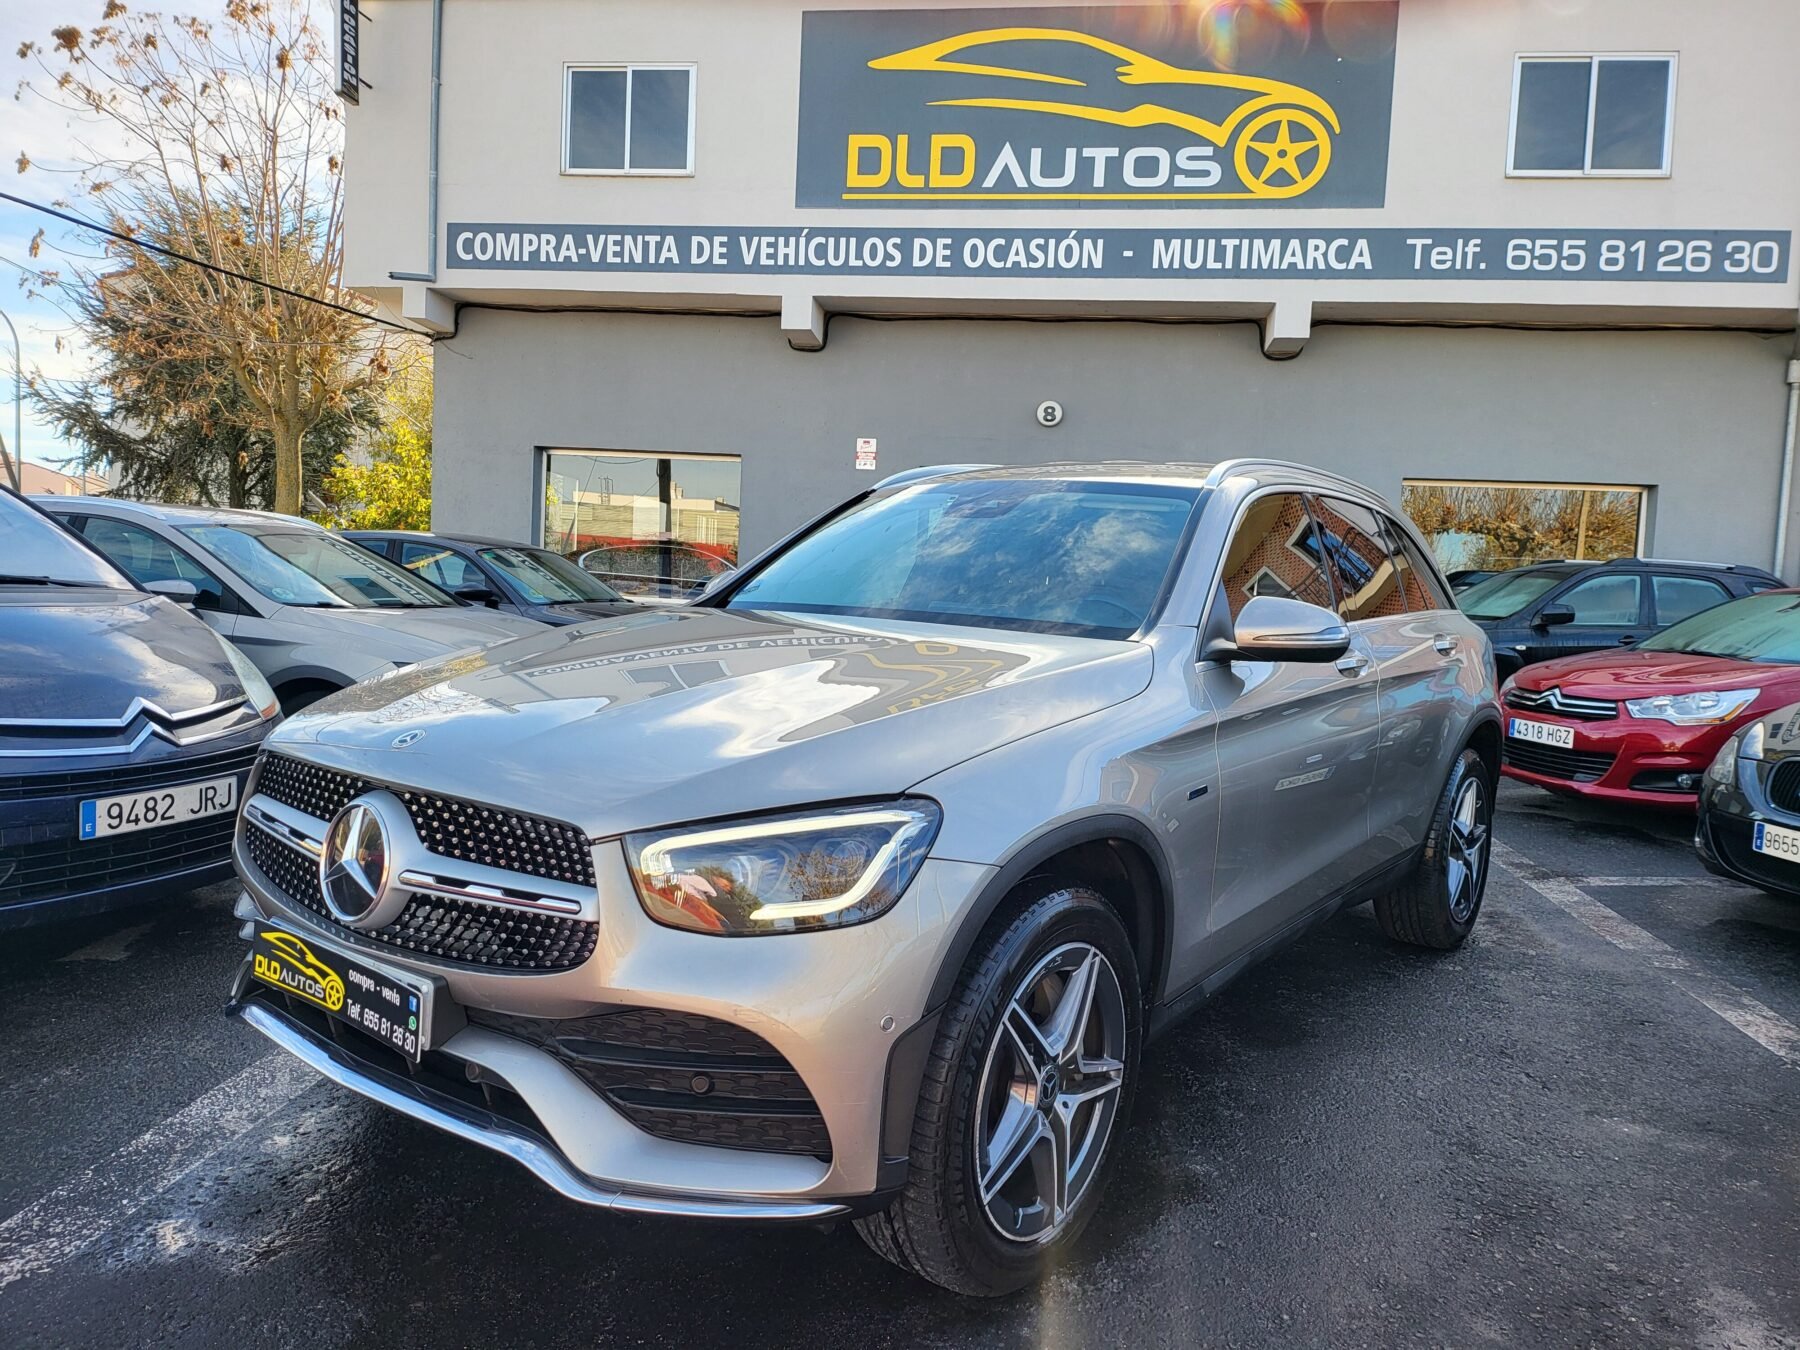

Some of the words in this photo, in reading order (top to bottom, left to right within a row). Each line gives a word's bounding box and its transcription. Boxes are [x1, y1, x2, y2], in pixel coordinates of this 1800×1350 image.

[847, 134, 976, 188] DLD
[981, 142, 1222, 188] AUTOS
[456, 231, 680, 265] COMPRA-VENTA
[691, 235, 728, 265] DE
[740, 229, 902, 268] VEHÍCULOS
[912, 237, 952, 268] DE
[963, 230, 1104, 269] OCASIÓN
[1152, 238, 1373, 270] MULTIMARCA
[1407, 238, 1486, 270] Telf.
[1506, 239, 1586, 271] 655
[1723, 240, 1779, 274] 30
[1043, 406, 1057, 422] 8
[1516, 722, 1543, 740] 4318
[1547, 727, 1571, 744] HGZ
[85, 823, 92, 832] E
[106, 793, 175, 830] 9482
[190, 782, 232, 815] JRJ
[1765, 831, 1800, 856] 9655
[255, 954, 281, 980] DLD
[280, 967, 325, 999] AUTOS
[348, 969, 375, 992] compra
[381, 986, 400, 1006] venta
[346, 998, 361, 1022] Telf.
[363, 1008, 380, 1032] 655
[380, 1017, 390, 1039] 81
[392, 1025, 404, 1046] 26
[404, 1033, 416, 1054] 30
